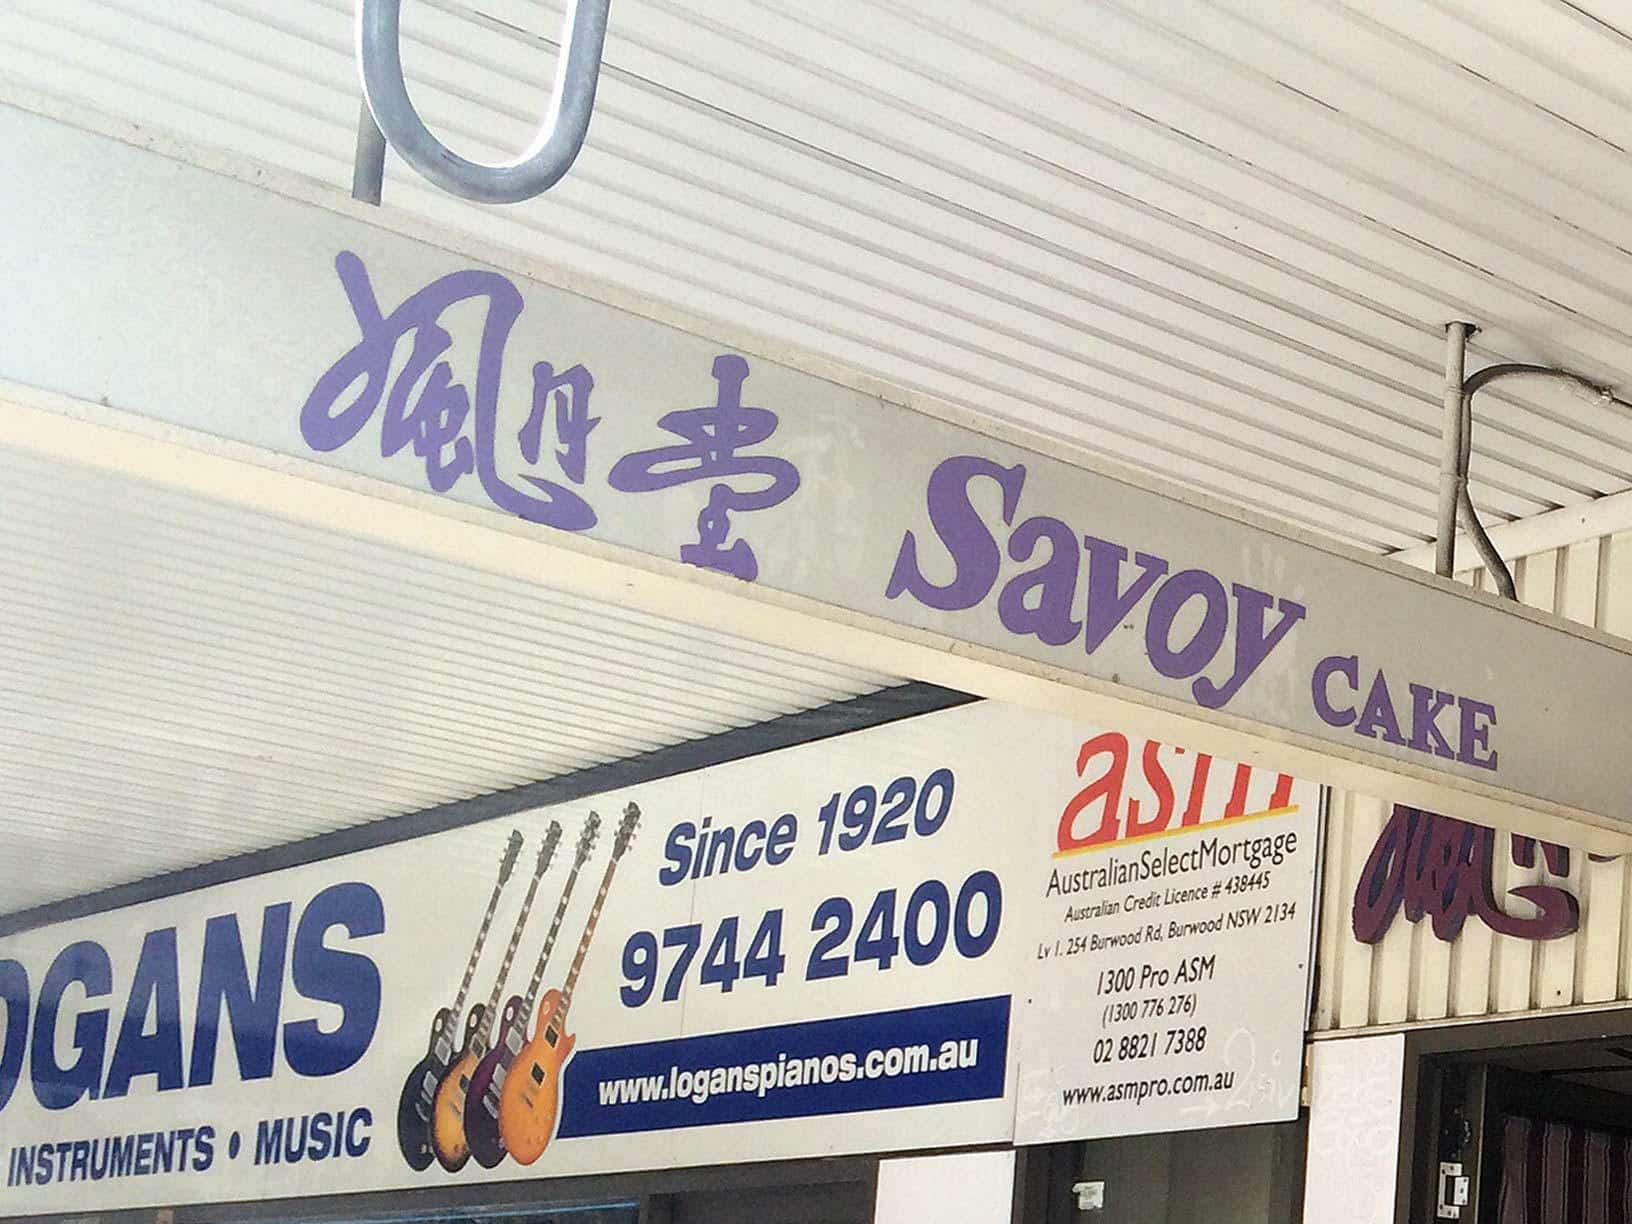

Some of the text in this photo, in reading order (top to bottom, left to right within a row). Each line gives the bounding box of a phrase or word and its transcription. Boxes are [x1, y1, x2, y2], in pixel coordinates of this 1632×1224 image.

[885, 455, 1306, 709] Savoy
[1311, 655, 1499, 771] CAKE
[658, 768, 955, 886] Since 1920
[1046, 831, 1297, 898] AustralianSelectMortgage
[1064, 871, 1271, 922] Australian Credit Licence # 438445
[619, 870, 1004, 1008] 9744 2400
[1037, 944, 1051, 960] Lv
[1066, 936, 1087, 956] 254
[1090, 927, 1141, 952] Burwood
[1146, 924, 1164, 943] Rd,
[1168, 913, 1223, 939] Burwood
[1226, 907, 1261, 930] NSW
[1264, 901, 1297, 924] 2134
[1097, 955, 1216, 995] 1300 Pro ASM
[1102, 993, 1197, 1028] (1300 776 276)
[599, 1039, 979, 1106] www.loganspianos.com.au
[1093, 1026, 1207, 1063] 02 8821 7388
[1063, 1071, 1235, 1106] www.asmpro.com.au
[8, 1107, 372, 1187] INSTRUMENTS MUSIC
